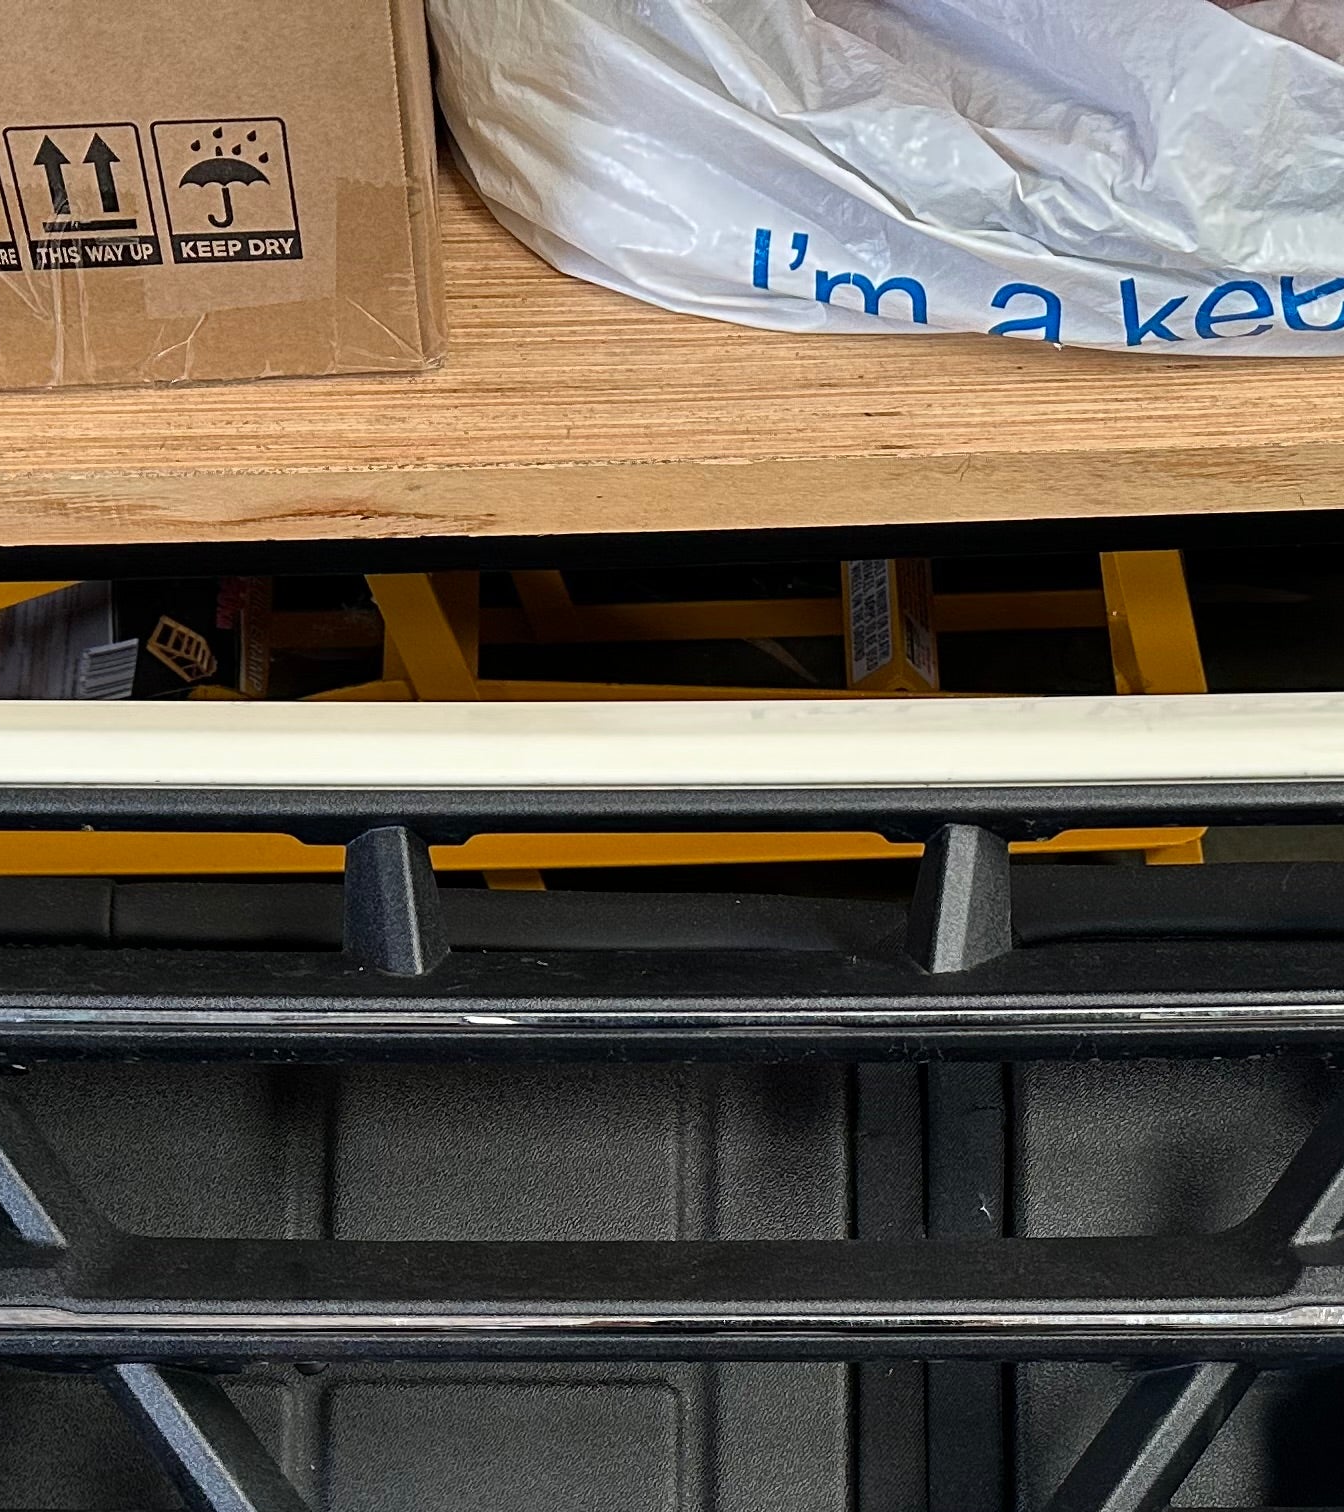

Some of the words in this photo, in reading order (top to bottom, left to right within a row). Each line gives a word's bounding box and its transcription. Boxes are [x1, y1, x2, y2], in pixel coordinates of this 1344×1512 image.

[37, 245, 82, 266] THIS
[86, 244, 125, 263] WAY
[129, 243, 154, 261] UP
[180, 240, 242, 258] KEEP
[248, 237, 295, 256] DRY
[988, 281, 1064, 345] a
